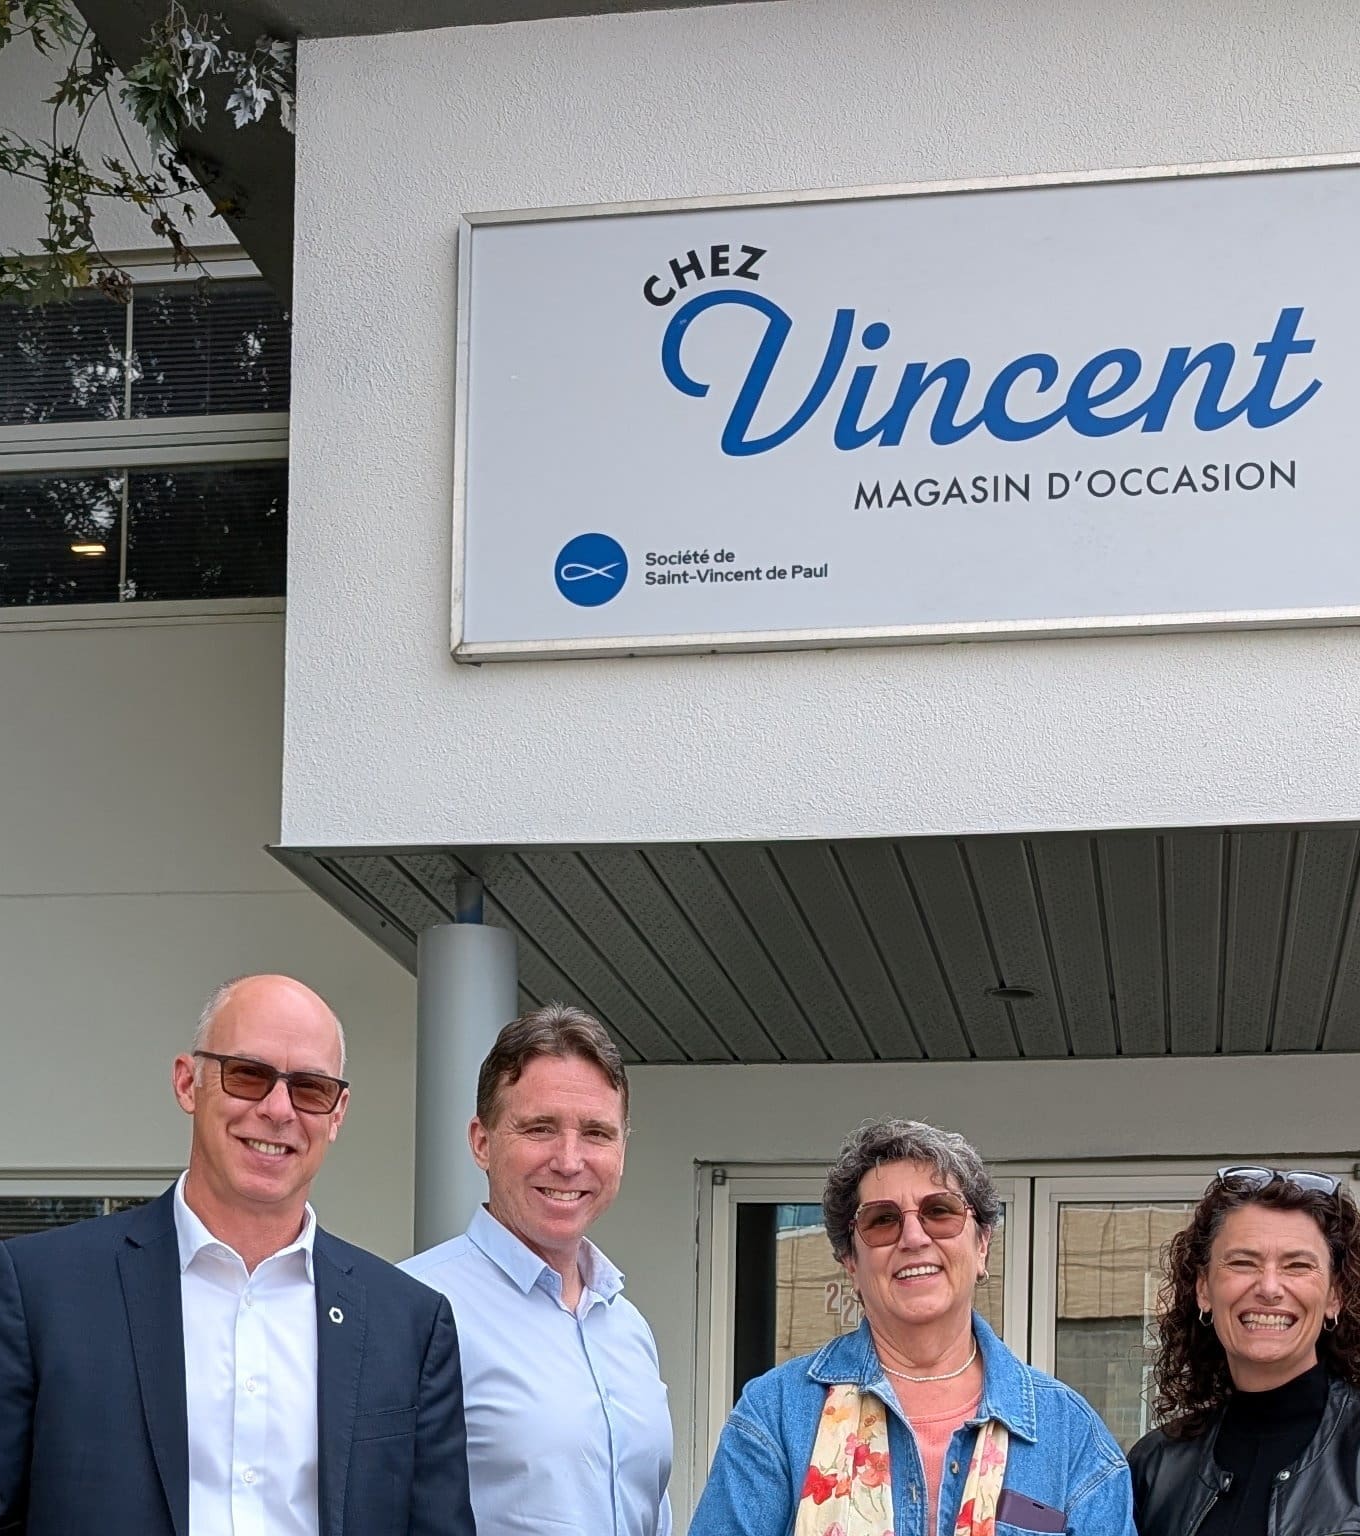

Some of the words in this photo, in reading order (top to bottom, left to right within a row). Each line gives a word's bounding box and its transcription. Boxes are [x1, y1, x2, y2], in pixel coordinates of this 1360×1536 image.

[643, 243, 768, 307] CHEZ
[661, 288, 1324, 457] Vincent
[853, 472, 1031, 511] MAGASIN
[644, 566, 763, 586] Saint-Vincent
[765, 566, 788, 580] de
[791, 562, 829, 579] Paul
[645, 549, 710, 566] Société
[713, 548, 736, 563] de
